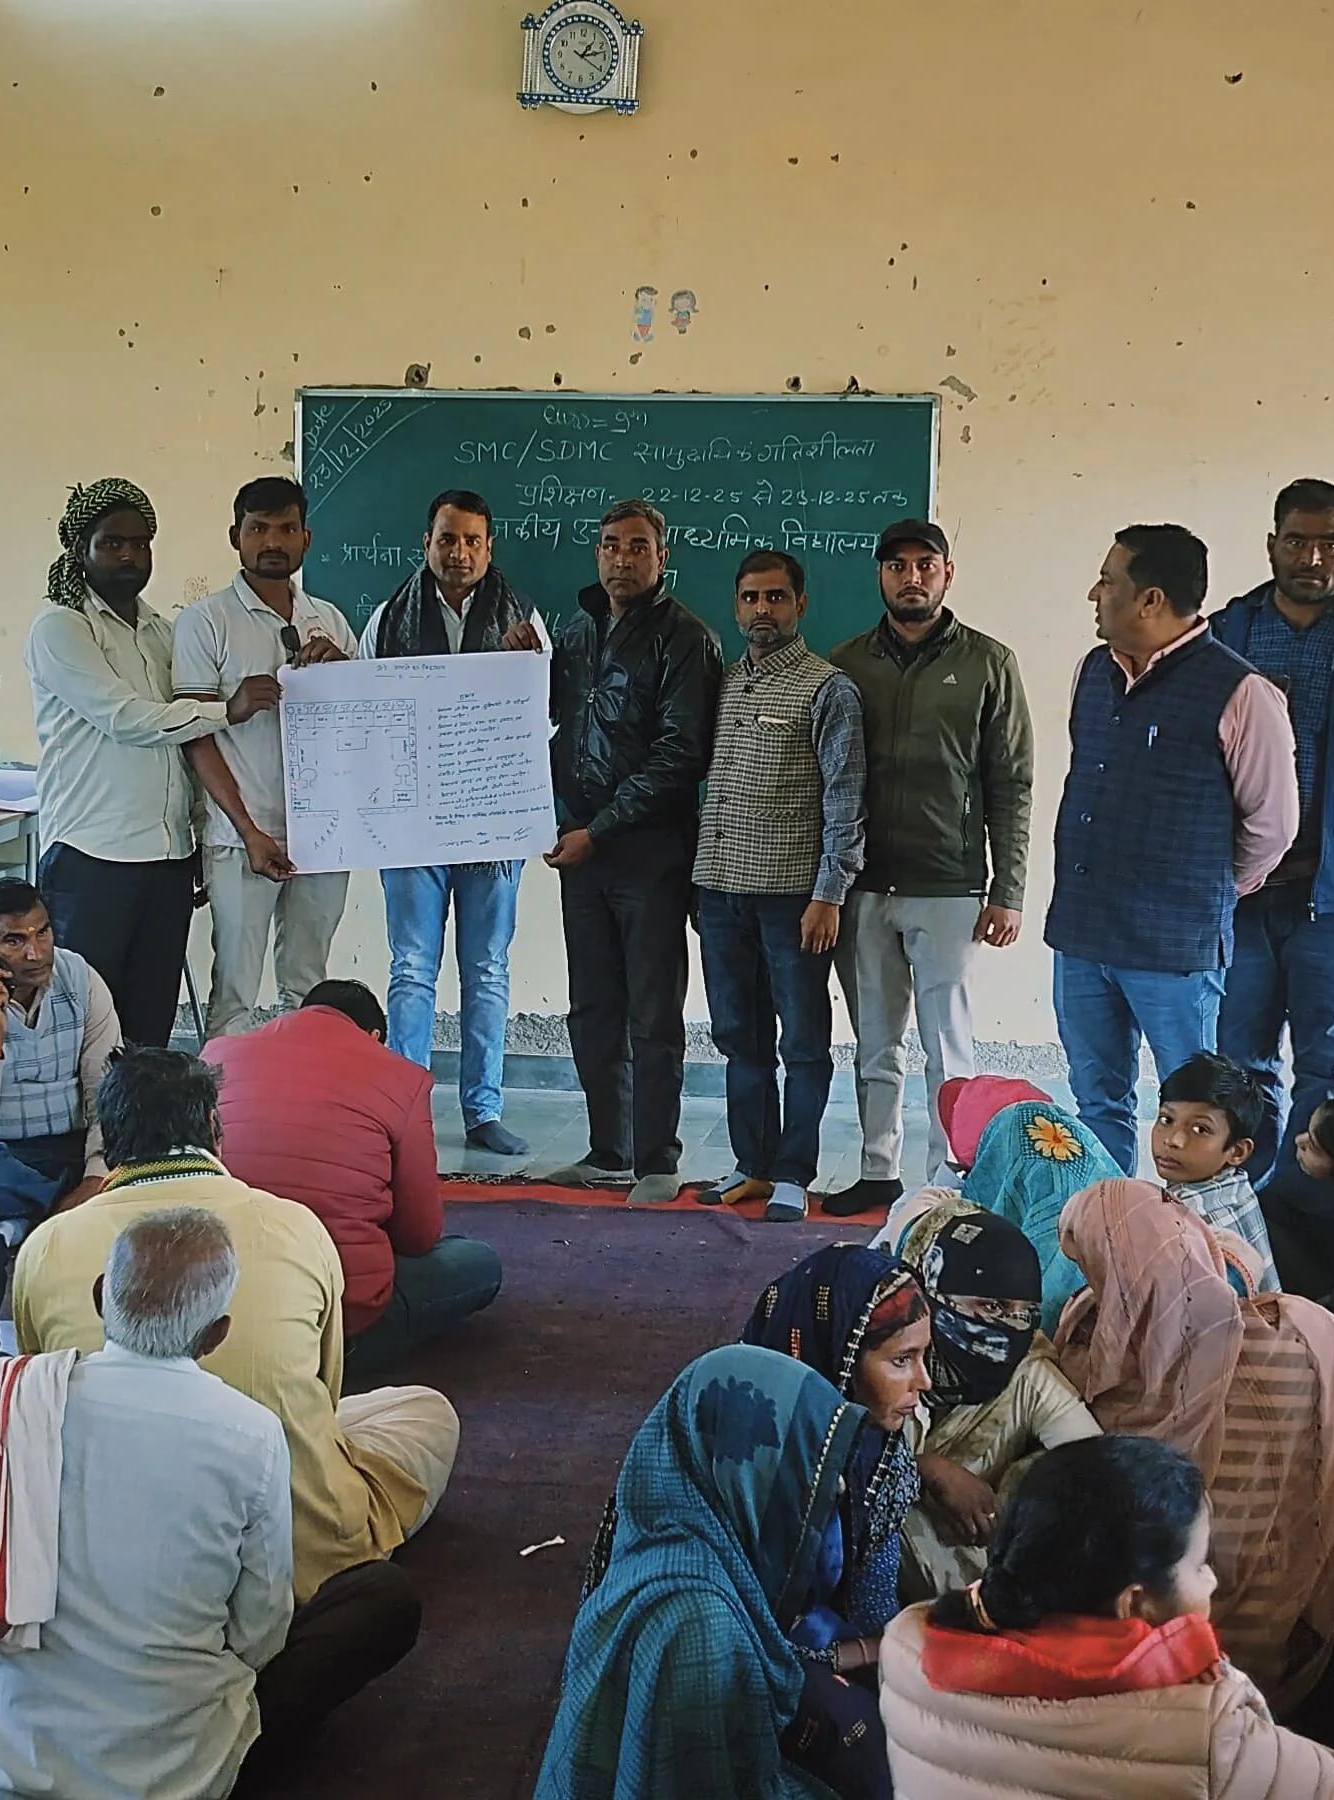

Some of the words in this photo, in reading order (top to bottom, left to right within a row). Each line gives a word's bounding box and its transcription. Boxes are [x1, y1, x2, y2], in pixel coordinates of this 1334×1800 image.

[304, 404, 335, 450] Date
[454, 429, 613, 468] SMC/SDMC
[642, 487, 744, 503] 22-12-25
[751, 479, 773, 506] से
